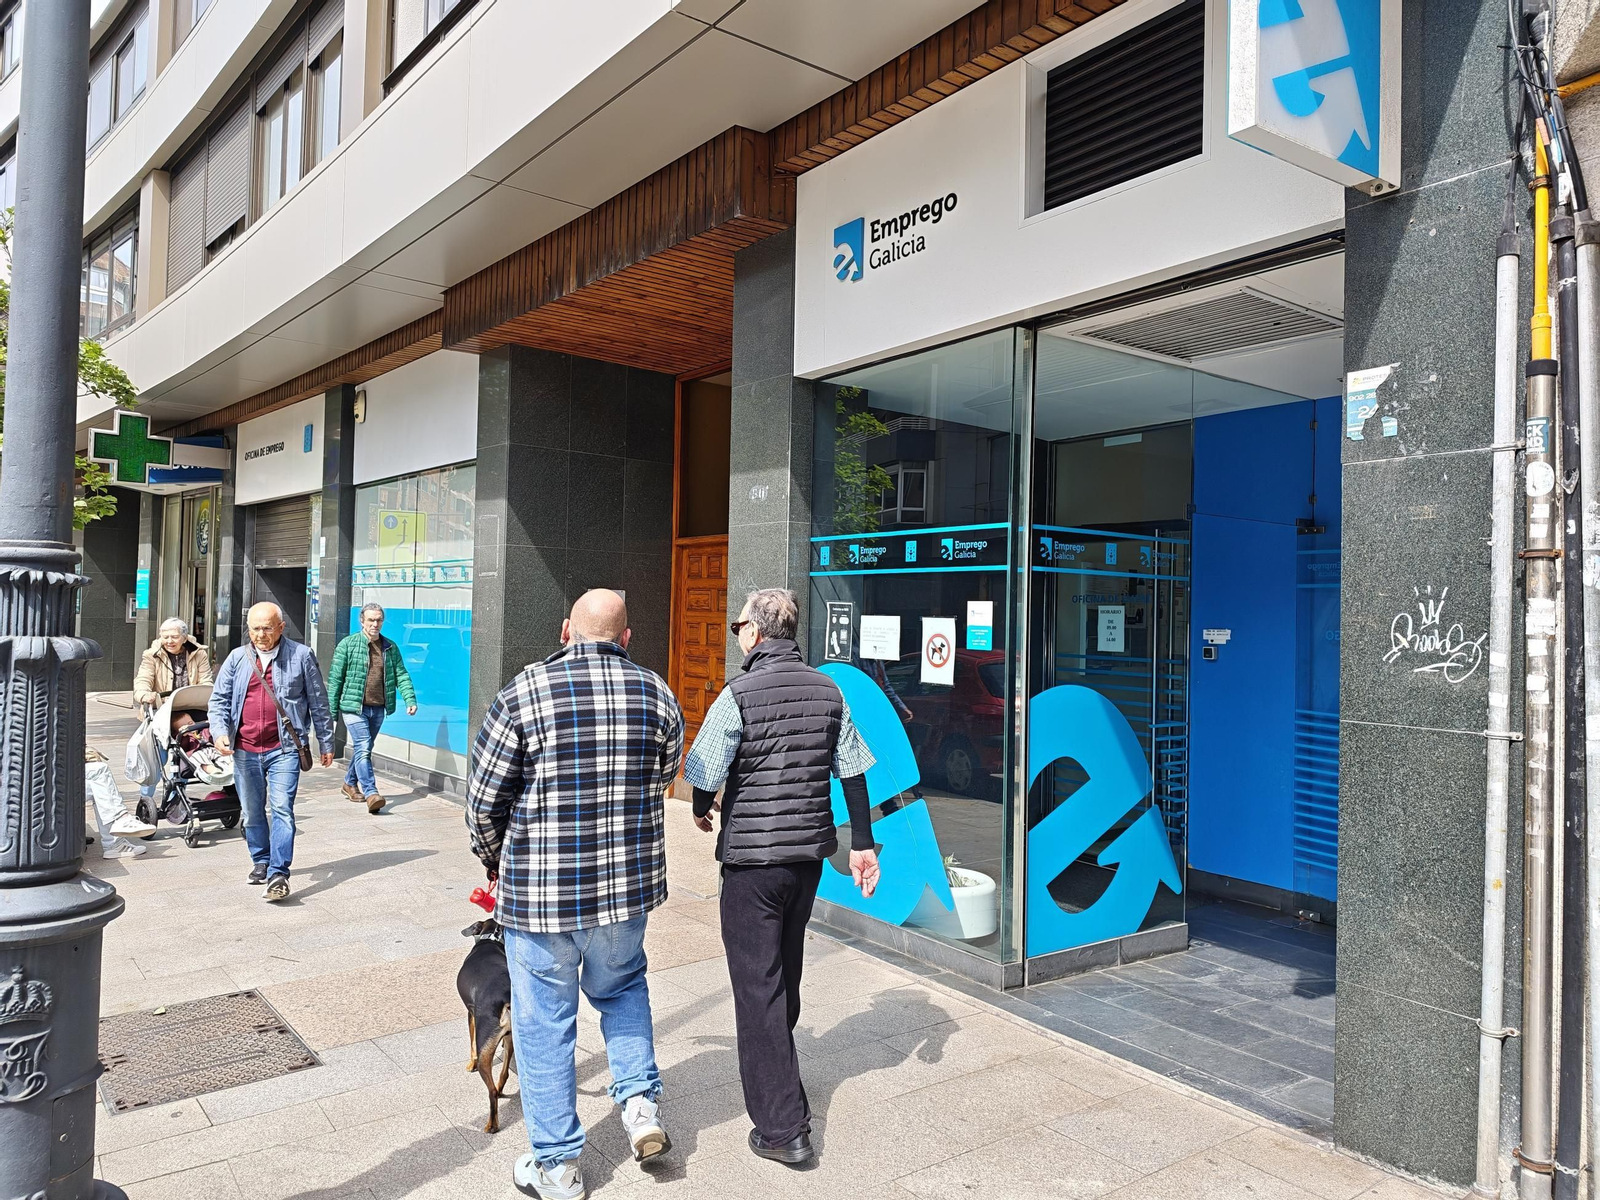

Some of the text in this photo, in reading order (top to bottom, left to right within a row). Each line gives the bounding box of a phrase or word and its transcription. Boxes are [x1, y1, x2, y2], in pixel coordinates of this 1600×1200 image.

[870, 192, 958, 243] Emprego
[869, 234, 926, 269] Galicia
[244, 441, 285, 461] OFICINA DE EMPREGO
[954, 540, 988, 550] Emprego
[1054, 541, 1085, 553] Emprego
[860, 546, 887, 555] Emprego
[954, 550, 977, 559] Galicia
[860, 555, 878, 563] Galicia
[1054, 551, 1075, 561] Galicia
[1072, 595, 1106, 604] OFICINA
